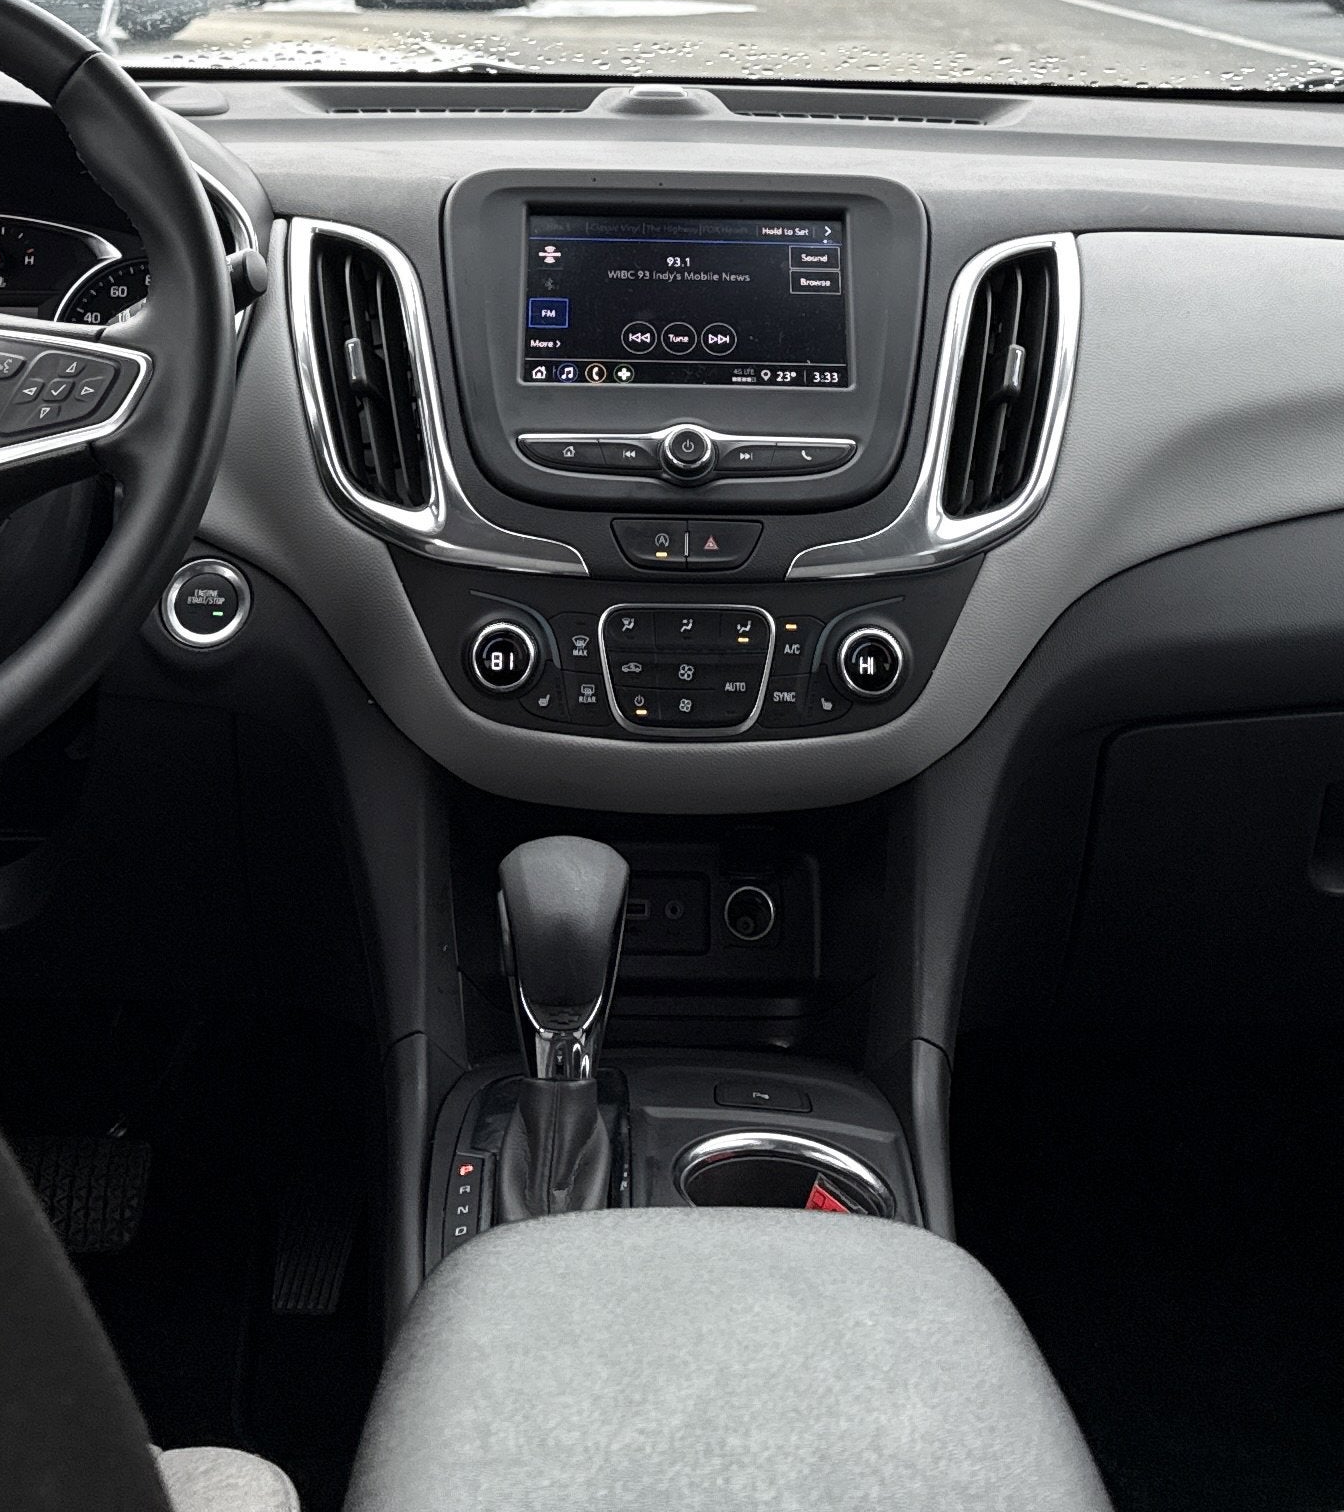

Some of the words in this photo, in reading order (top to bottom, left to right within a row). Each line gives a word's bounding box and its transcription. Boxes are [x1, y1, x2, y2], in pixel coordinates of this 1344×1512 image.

[761, 226, 782, 236] Hold
[784, 227, 793, 236] to
[795, 227, 810, 237] Set
[24, 255, 35, 266] H
[666, 256, 691, 267] 93.1
[801, 254, 828, 263] Sound
[607, 270, 635, 280] WIBC
[637, 271, 650, 280] 93
[652, 271, 682, 283] Indy's
[684, 271, 719, 281] Mobile
[722, 273, 750, 282] News
[800, 278, 832, 287] Browse
[110, 285, 128, 299] 60
[83, 311, 101, 324] 40
[541, 309, 556, 318] FM
[530, 339, 553, 348] More
[668, 334, 689, 344] Tune
[813, 372, 839, 383] 3:33
[572, 649, 588, 657] MAX
[784, 643, 801, 655] A/C
[859, 656, 874, 675] HI
[724, 681, 746, 692] AUTO
[578, 695, 597, 703] REAR
[773, 691, 796, 703] SYNC
[459, 1164, 474, 1176] P
[456, 1205, 469, 1215] N
[454, 1226, 467, 1237] D
